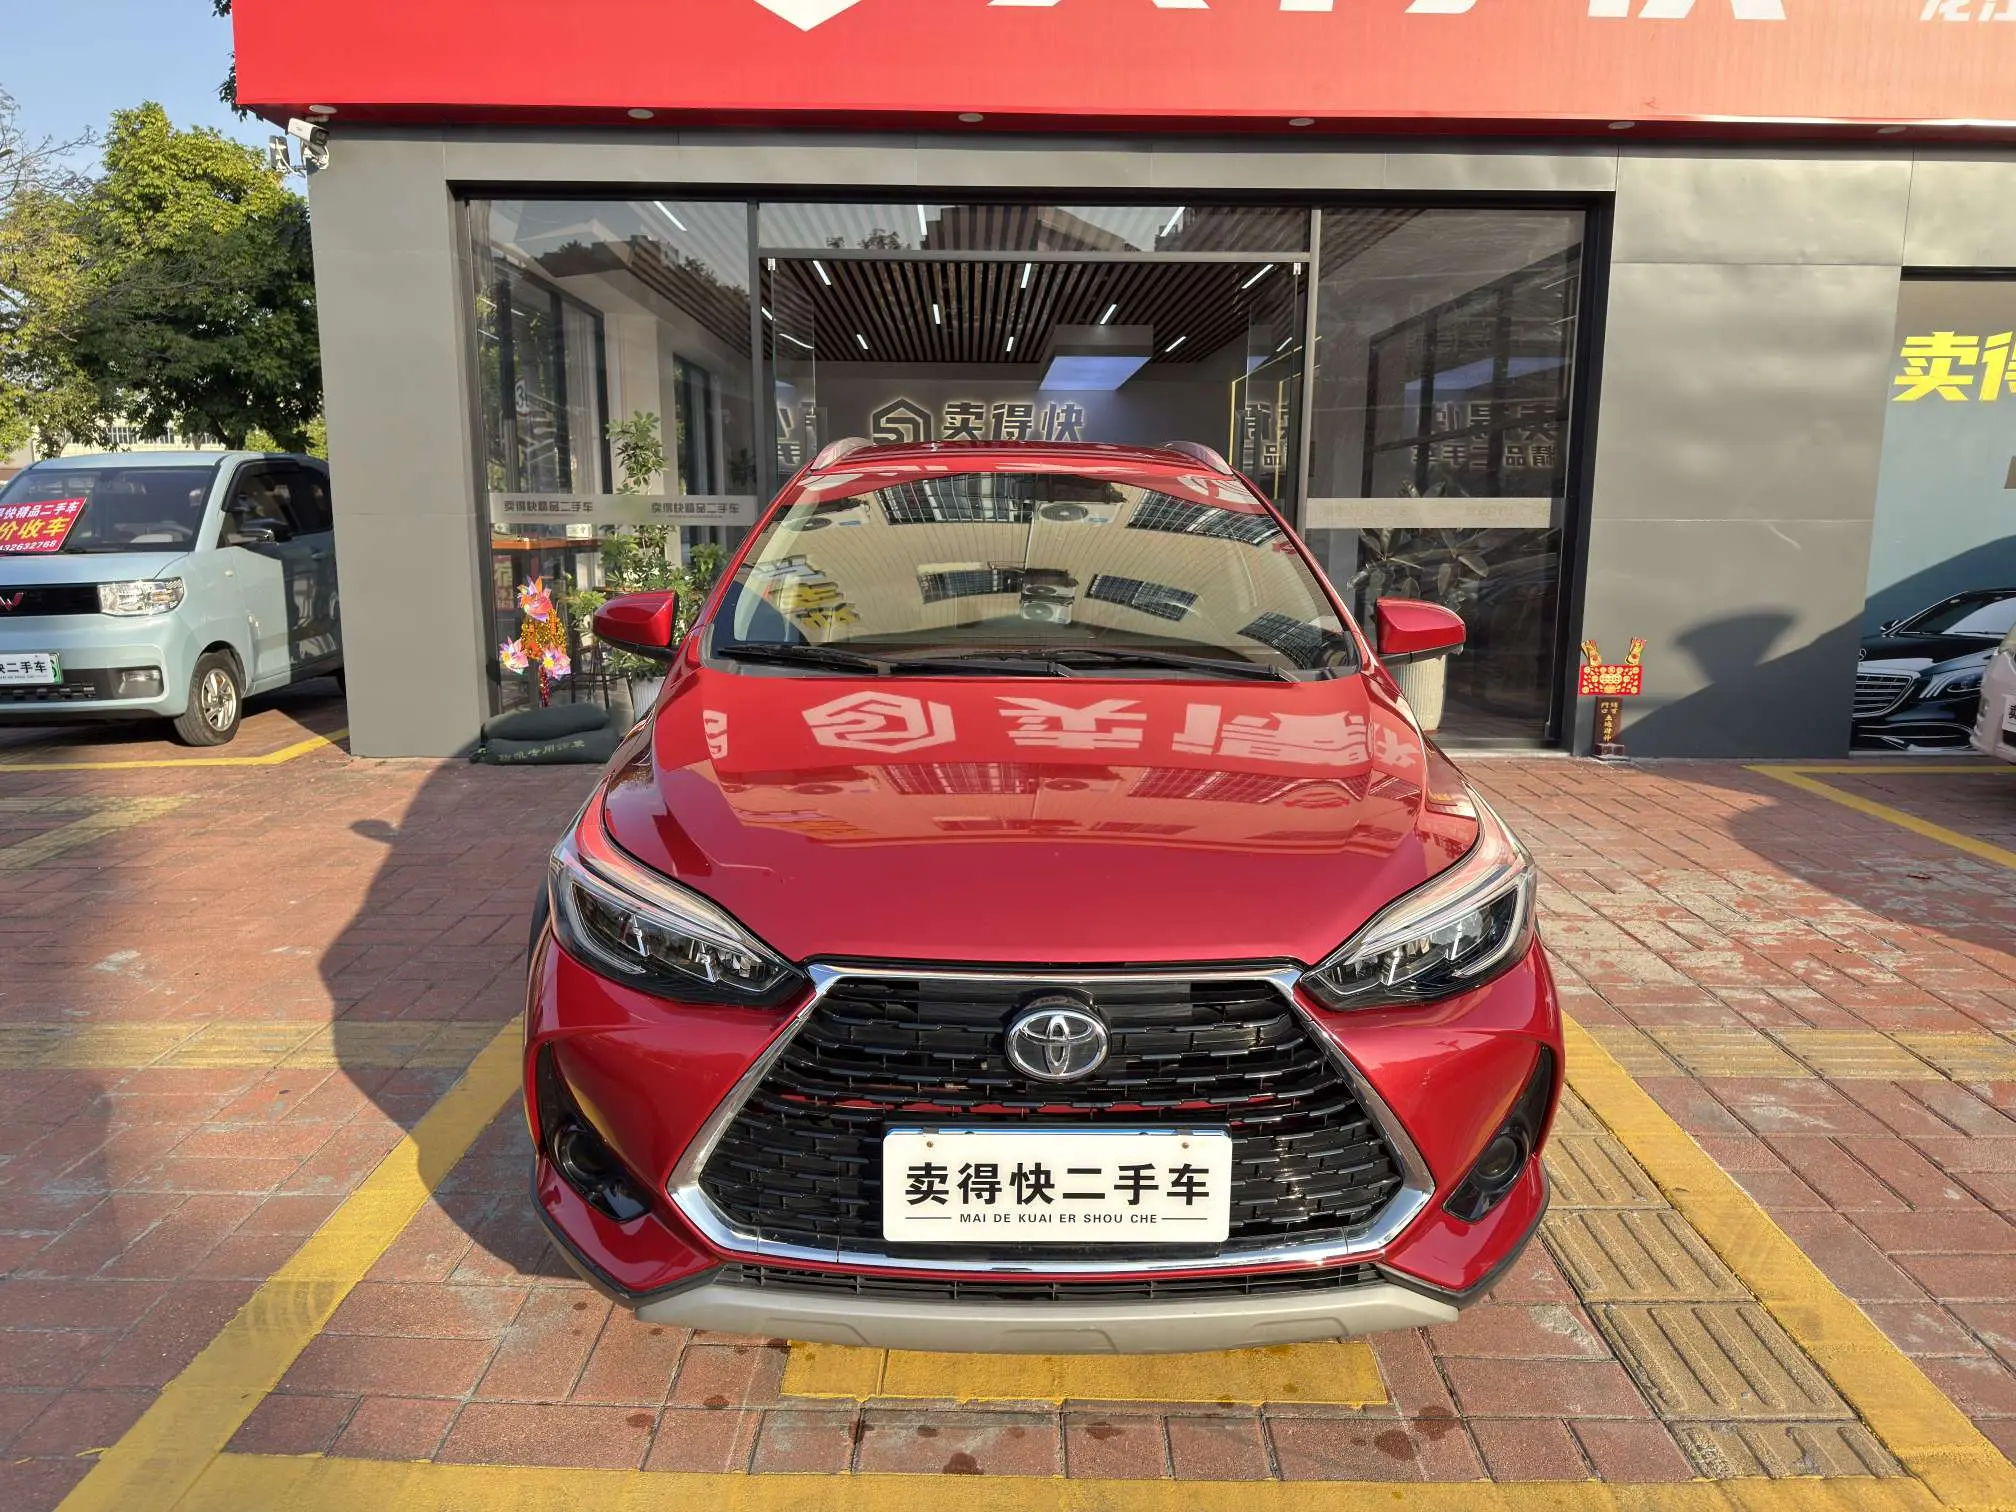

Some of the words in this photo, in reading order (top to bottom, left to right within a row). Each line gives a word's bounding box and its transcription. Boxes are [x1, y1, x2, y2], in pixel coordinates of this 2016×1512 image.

[943, 401, 1086, 441] 卖得快
[905, 1162, 1210, 1206] 卖得快二手车
[960, 1213, 986, 1223] MAI
[993, 1213, 1011, 1223] DE
[1018, 1213, 1052, 1223] KUAI
[1059, 1213, 1076, 1223] ER
[1083, 1213, 1123, 1224] SHOU
[1130, 1213, 1157, 1224] CHE
